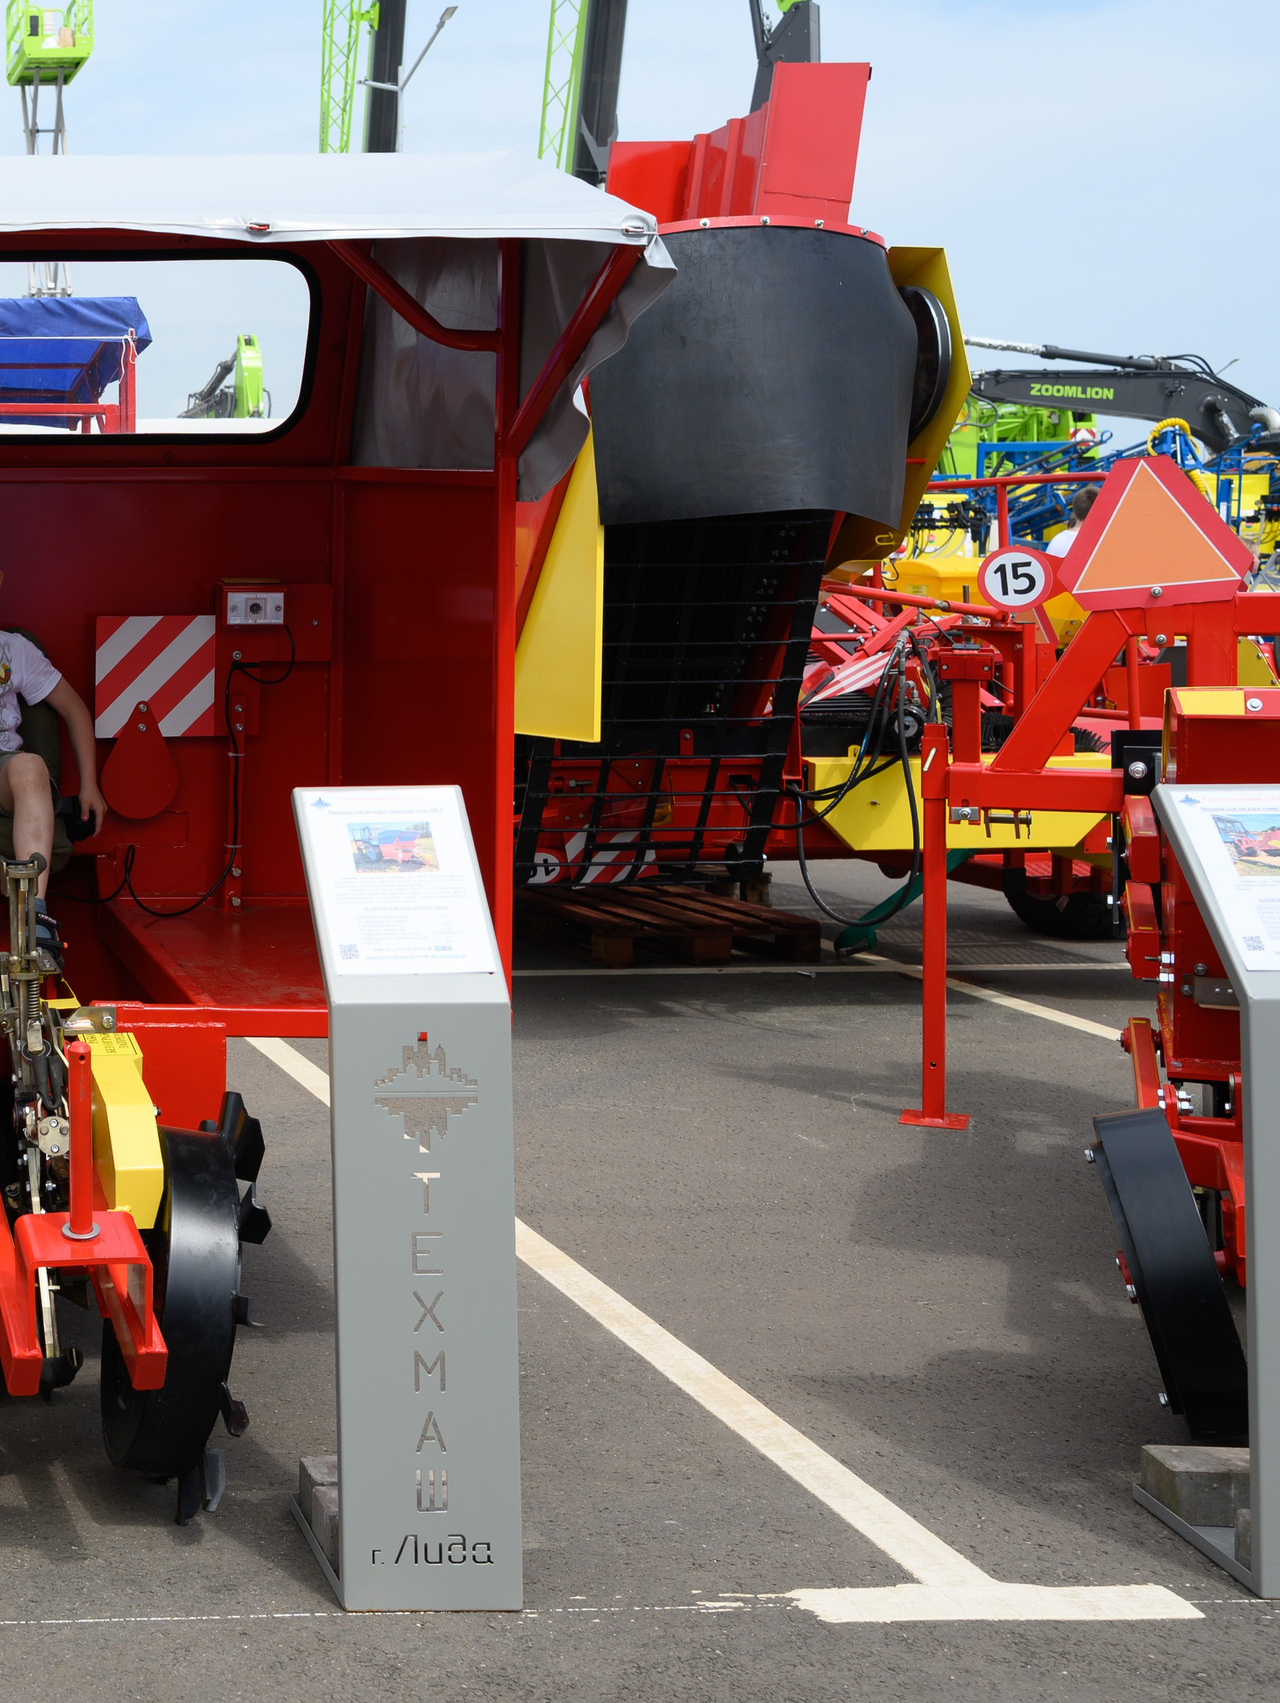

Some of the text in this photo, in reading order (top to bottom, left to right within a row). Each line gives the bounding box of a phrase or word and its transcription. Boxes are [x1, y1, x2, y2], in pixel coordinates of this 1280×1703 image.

[1029, 383, 1115, 401] ZOOMLION
[993, 561, 1037, 597] 15
[410, 1172, 449, 1513] ТЕХМАШ
[371, 1533, 495, 1566] г. Лида
